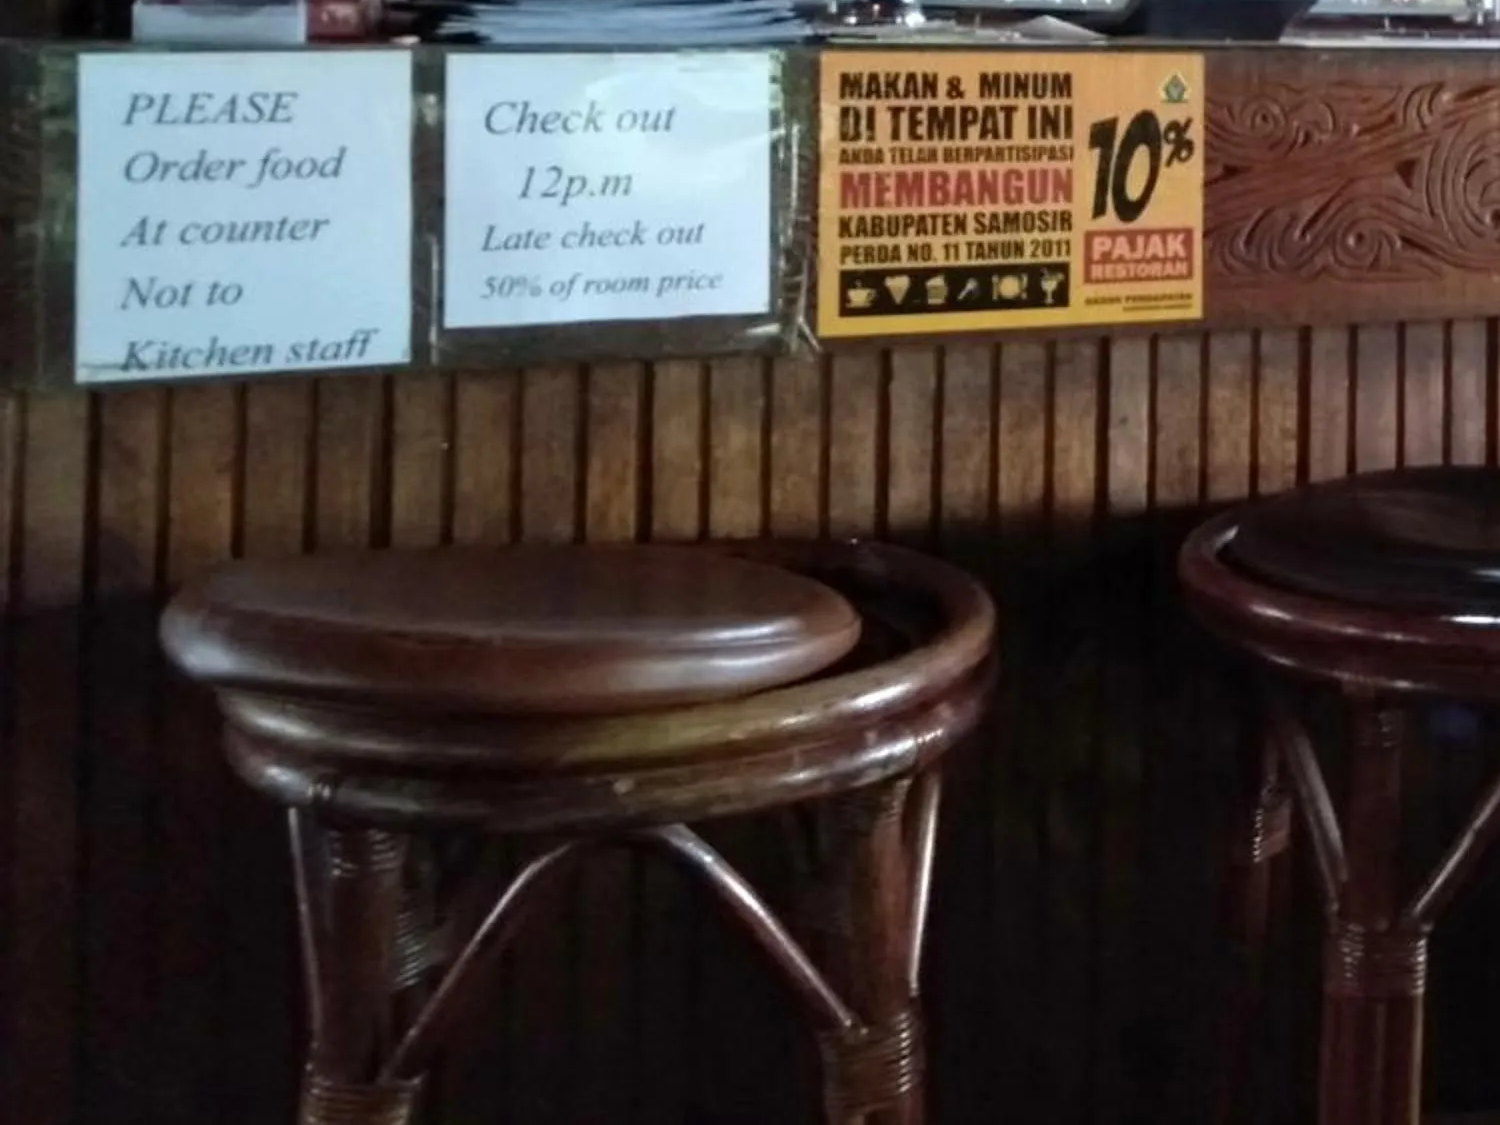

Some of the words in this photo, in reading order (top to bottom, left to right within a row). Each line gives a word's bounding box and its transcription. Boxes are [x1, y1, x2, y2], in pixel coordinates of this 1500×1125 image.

[839, 72, 939, 101] MAKAN
[945, 75, 966, 100] &
[979, 71, 1074, 100] MINUM
[122, 89, 299, 127] PLEASE
[484, 97, 604, 136] Check
[615, 104, 677, 134] out
[886, 105, 1019, 142] TEMPAT
[1027, 104, 1074, 141] INI
[123, 147, 248, 185] Order
[244, 144, 348, 190] food
[839, 147, 885, 165] ANDA
[1088, 109, 1195, 223] 10%
[517, 164, 634, 208] 12p.m
[838, 167, 1075, 210] MEMBANGUN
[119, 214, 168, 248] At
[178, 216, 331, 245] counter
[481, 223, 551, 252] Late
[559, 220, 647, 250] check
[656, 221, 706, 247] out
[838, 212, 968, 239] KABUPATEN
[972, 209, 1073, 236] SAMOSIR
[839, 243, 902, 265] PERDA
[906, 242, 938, 262] NO.
[942, 243, 961, 261] 11
[964, 239, 1026, 261] TAHUN
[1029, 237, 1071, 259] 2011
[1092, 233, 1187, 261] PAJAK
[479, 273, 543, 300] 50%
[549, 272, 583, 302] of
[583, 274, 651, 297] room
[655, 269, 724, 298] price
[1090, 261, 1188, 280] RESTORAN
[119, 275, 195, 311] Not
[206, 278, 245, 307] to
[119, 334, 276, 372] Kitchen
[285, 326, 381, 364] staff
